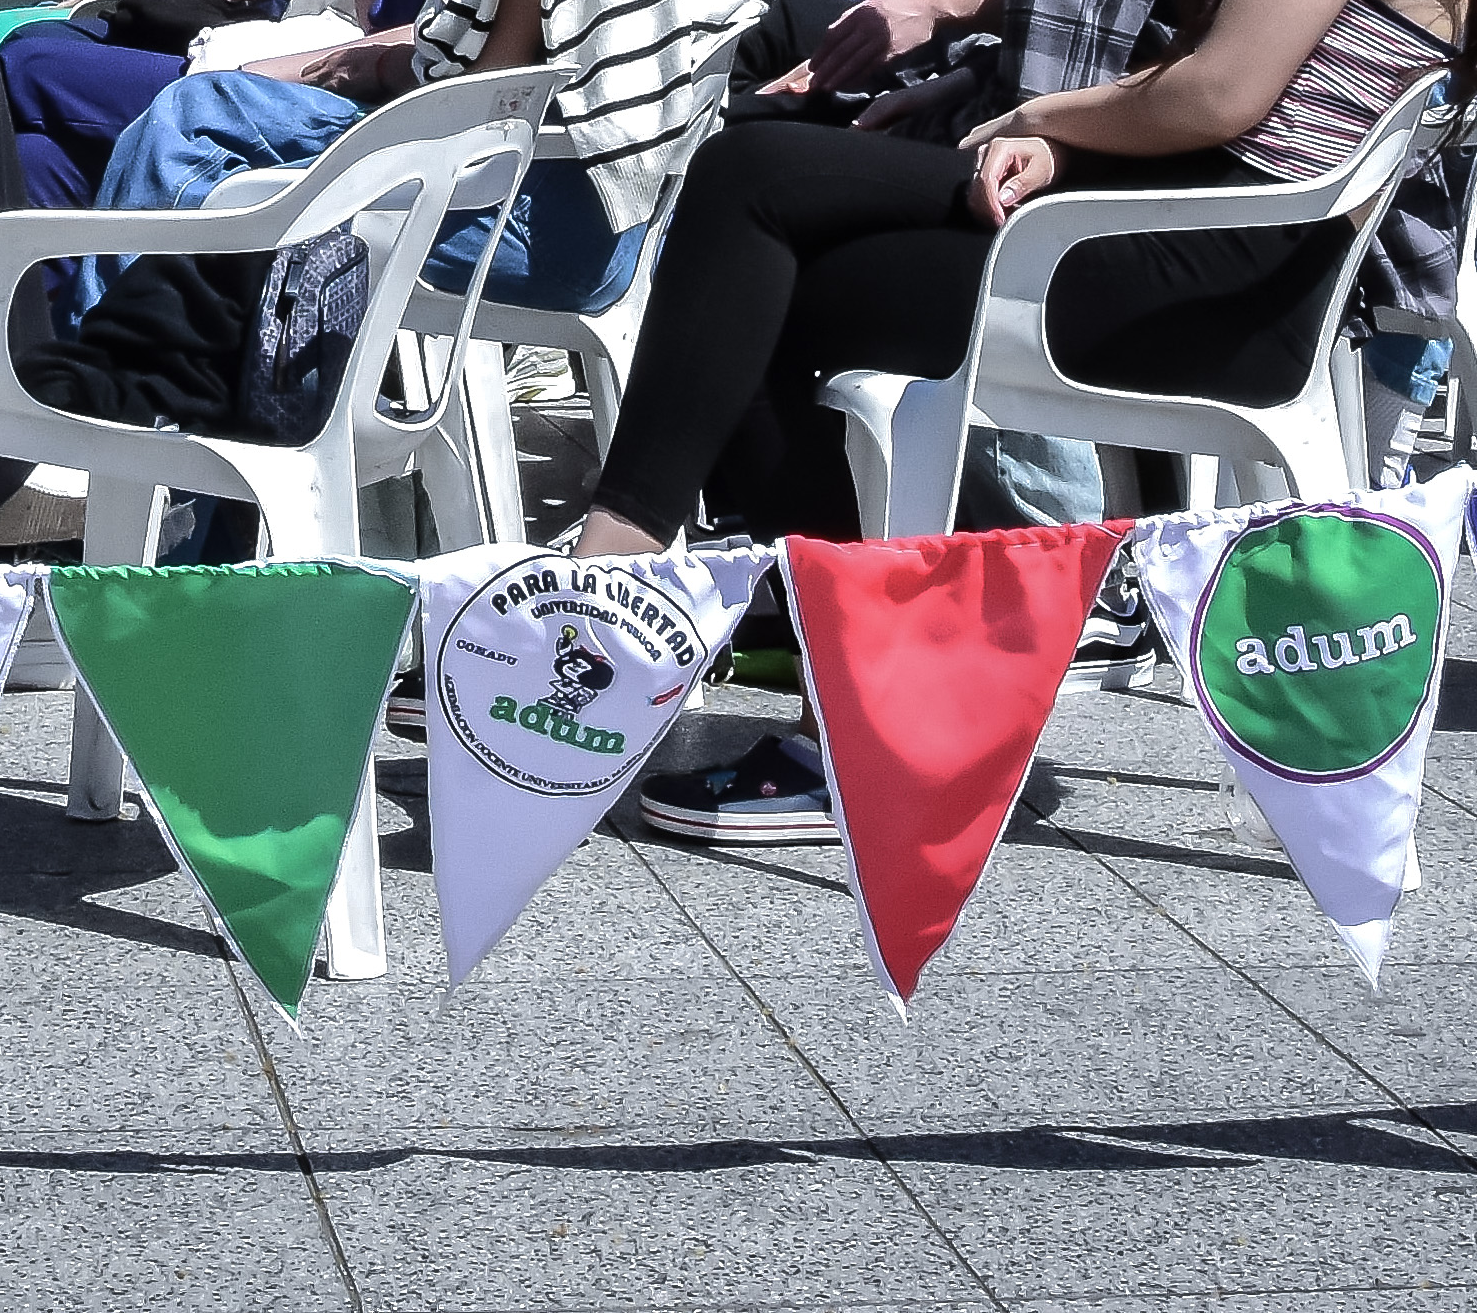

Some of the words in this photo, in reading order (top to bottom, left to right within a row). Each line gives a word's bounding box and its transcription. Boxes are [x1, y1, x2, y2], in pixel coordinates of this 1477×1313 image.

[491, 570, 560, 616] PARA
[571, 569, 597, 595] LA
[606, 581, 696, 668] LIBERTAD
[1235, 613, 1417, 676] adum
[489, 696, 625, 755] adum
